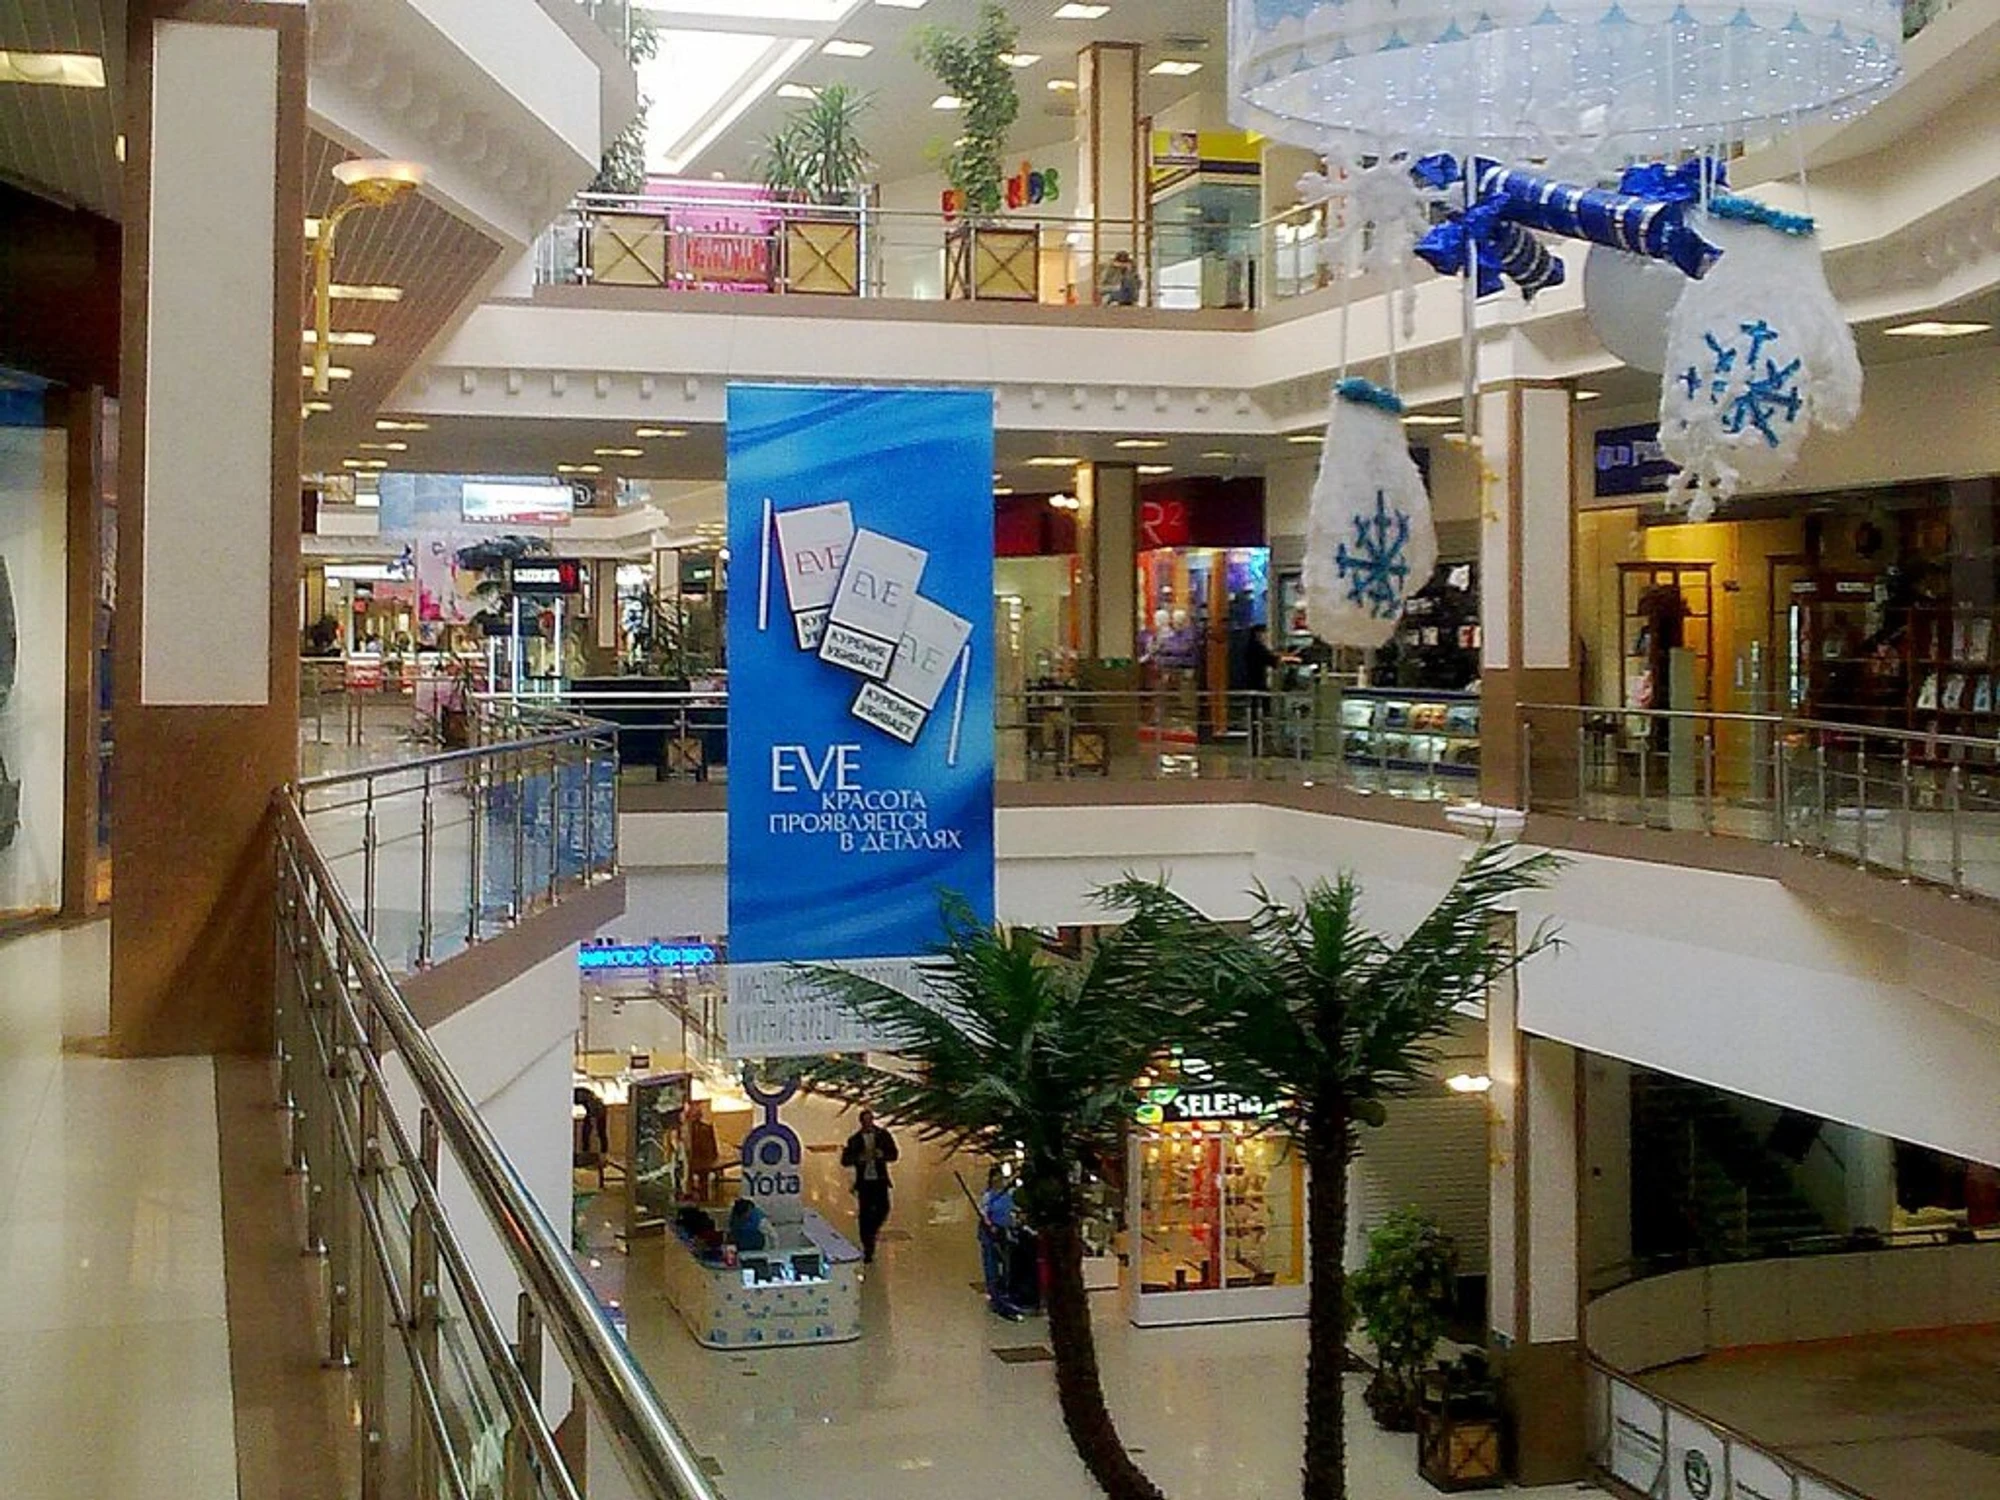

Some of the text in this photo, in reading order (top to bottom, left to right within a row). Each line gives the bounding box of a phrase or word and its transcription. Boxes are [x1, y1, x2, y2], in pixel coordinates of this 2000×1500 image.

[795, 543, 844, 577] EVE
[851, 570, 903, 608] EVE
[831, 631, 888, 658] КУРЕНИЕ
[865, 688, 921, 722] КУРЕНИЕ
[771, 745, 862, 792] EVE
[822, 791, 927, 811] КРАСОТА
[769, 811, 928, 833] ПРОЯВЛЯЕТСЯ
[840, 829, 962, 853] В ДЕТАЛЯХ
[743, 1170, 801, 1198] Yota
